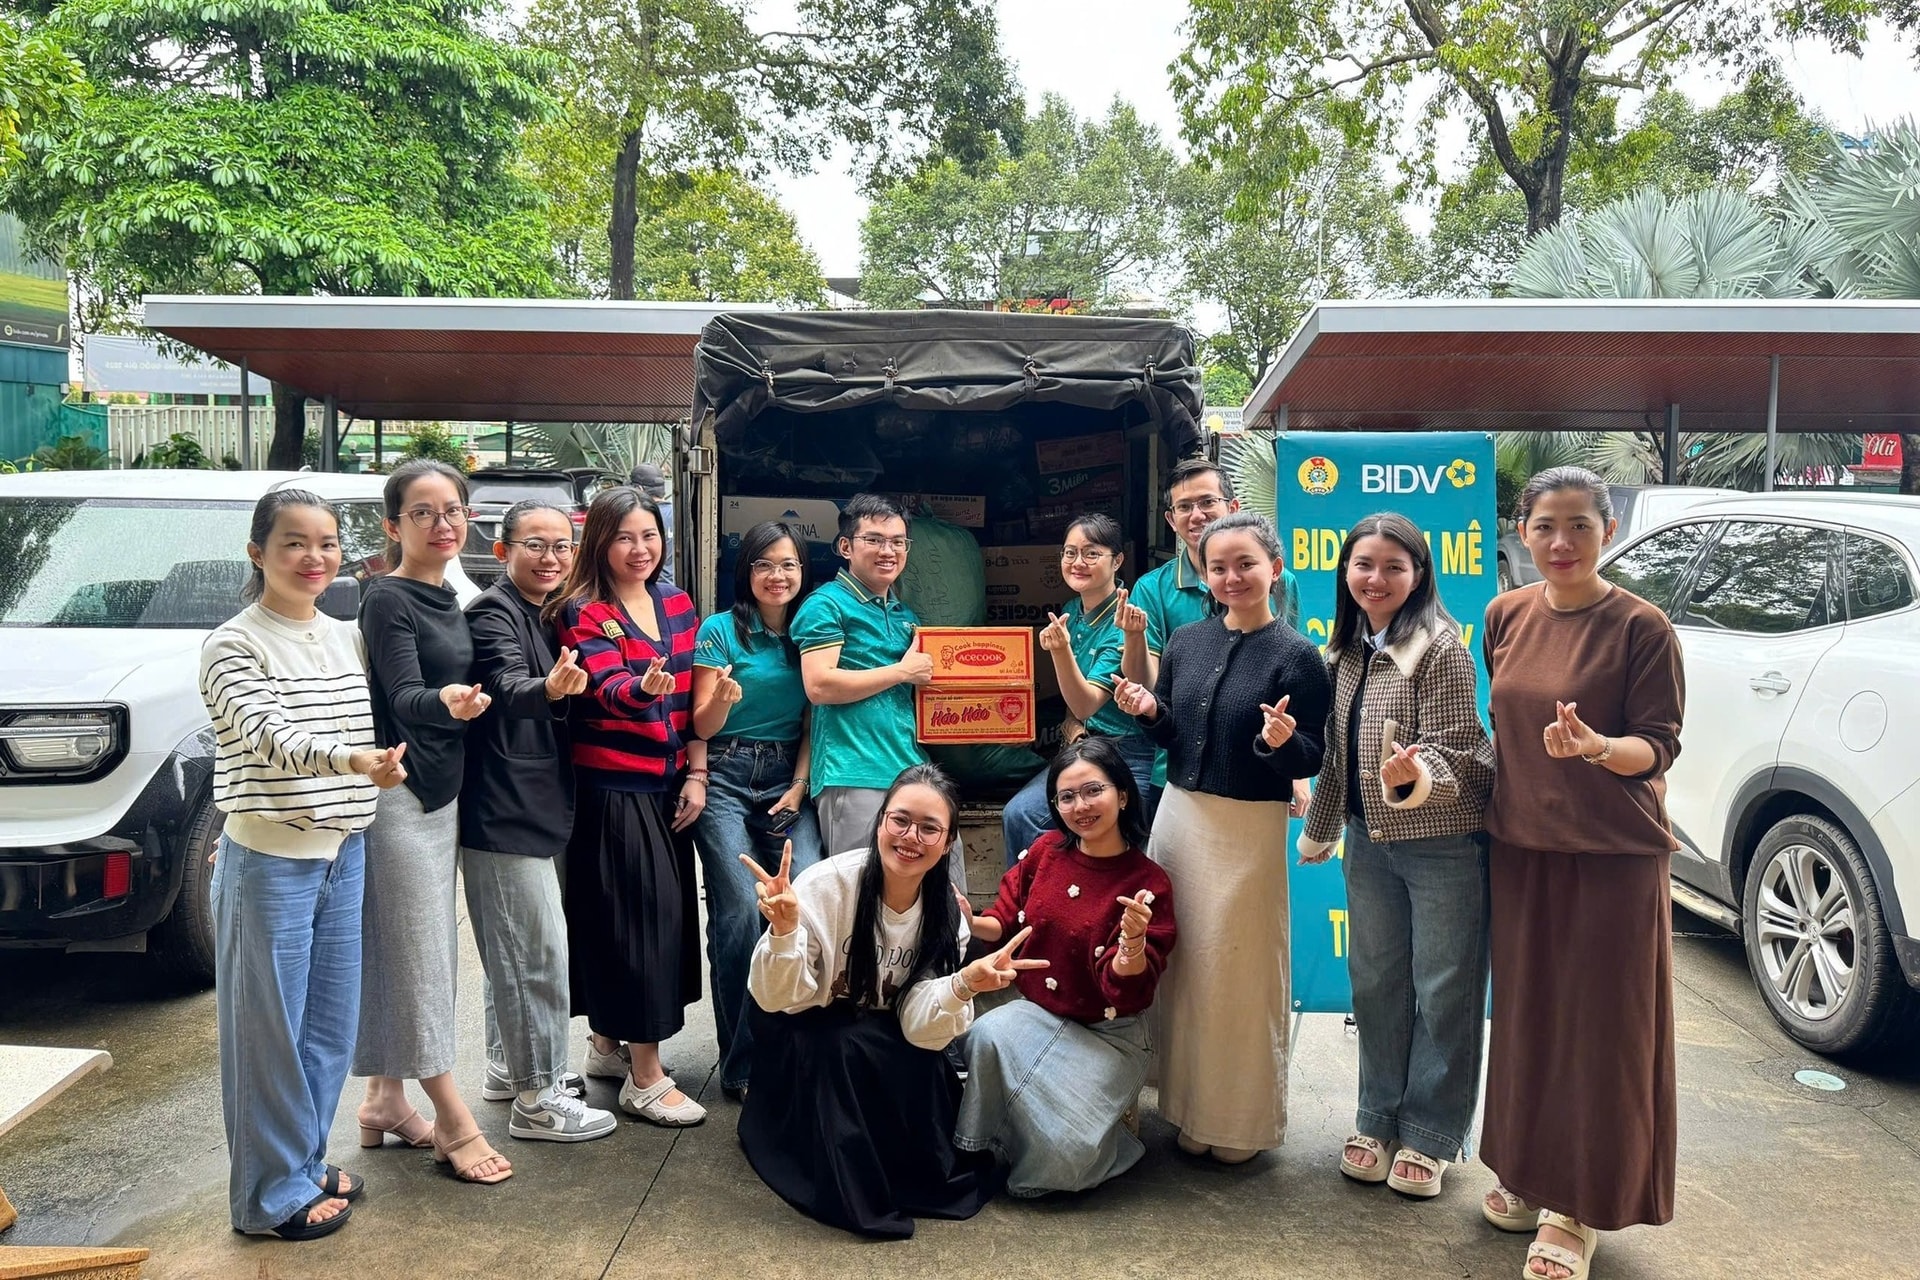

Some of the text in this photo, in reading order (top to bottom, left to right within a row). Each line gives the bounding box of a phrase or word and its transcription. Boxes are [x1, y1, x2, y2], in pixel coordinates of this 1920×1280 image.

[1867, 434, 1898, 457] Nữ
[1361, 464, 1447, 494] BIDV
[1292, 527, 1348, 571] BID
[1441, 519, 1483, 576] MÊ
[987, 603, 1062, 621] UGGIES
[954, 641, 1006, 652] Cook happiness
[931, 707, 960, 728] Hảo
[961, 703, 991, 724] Hảo
